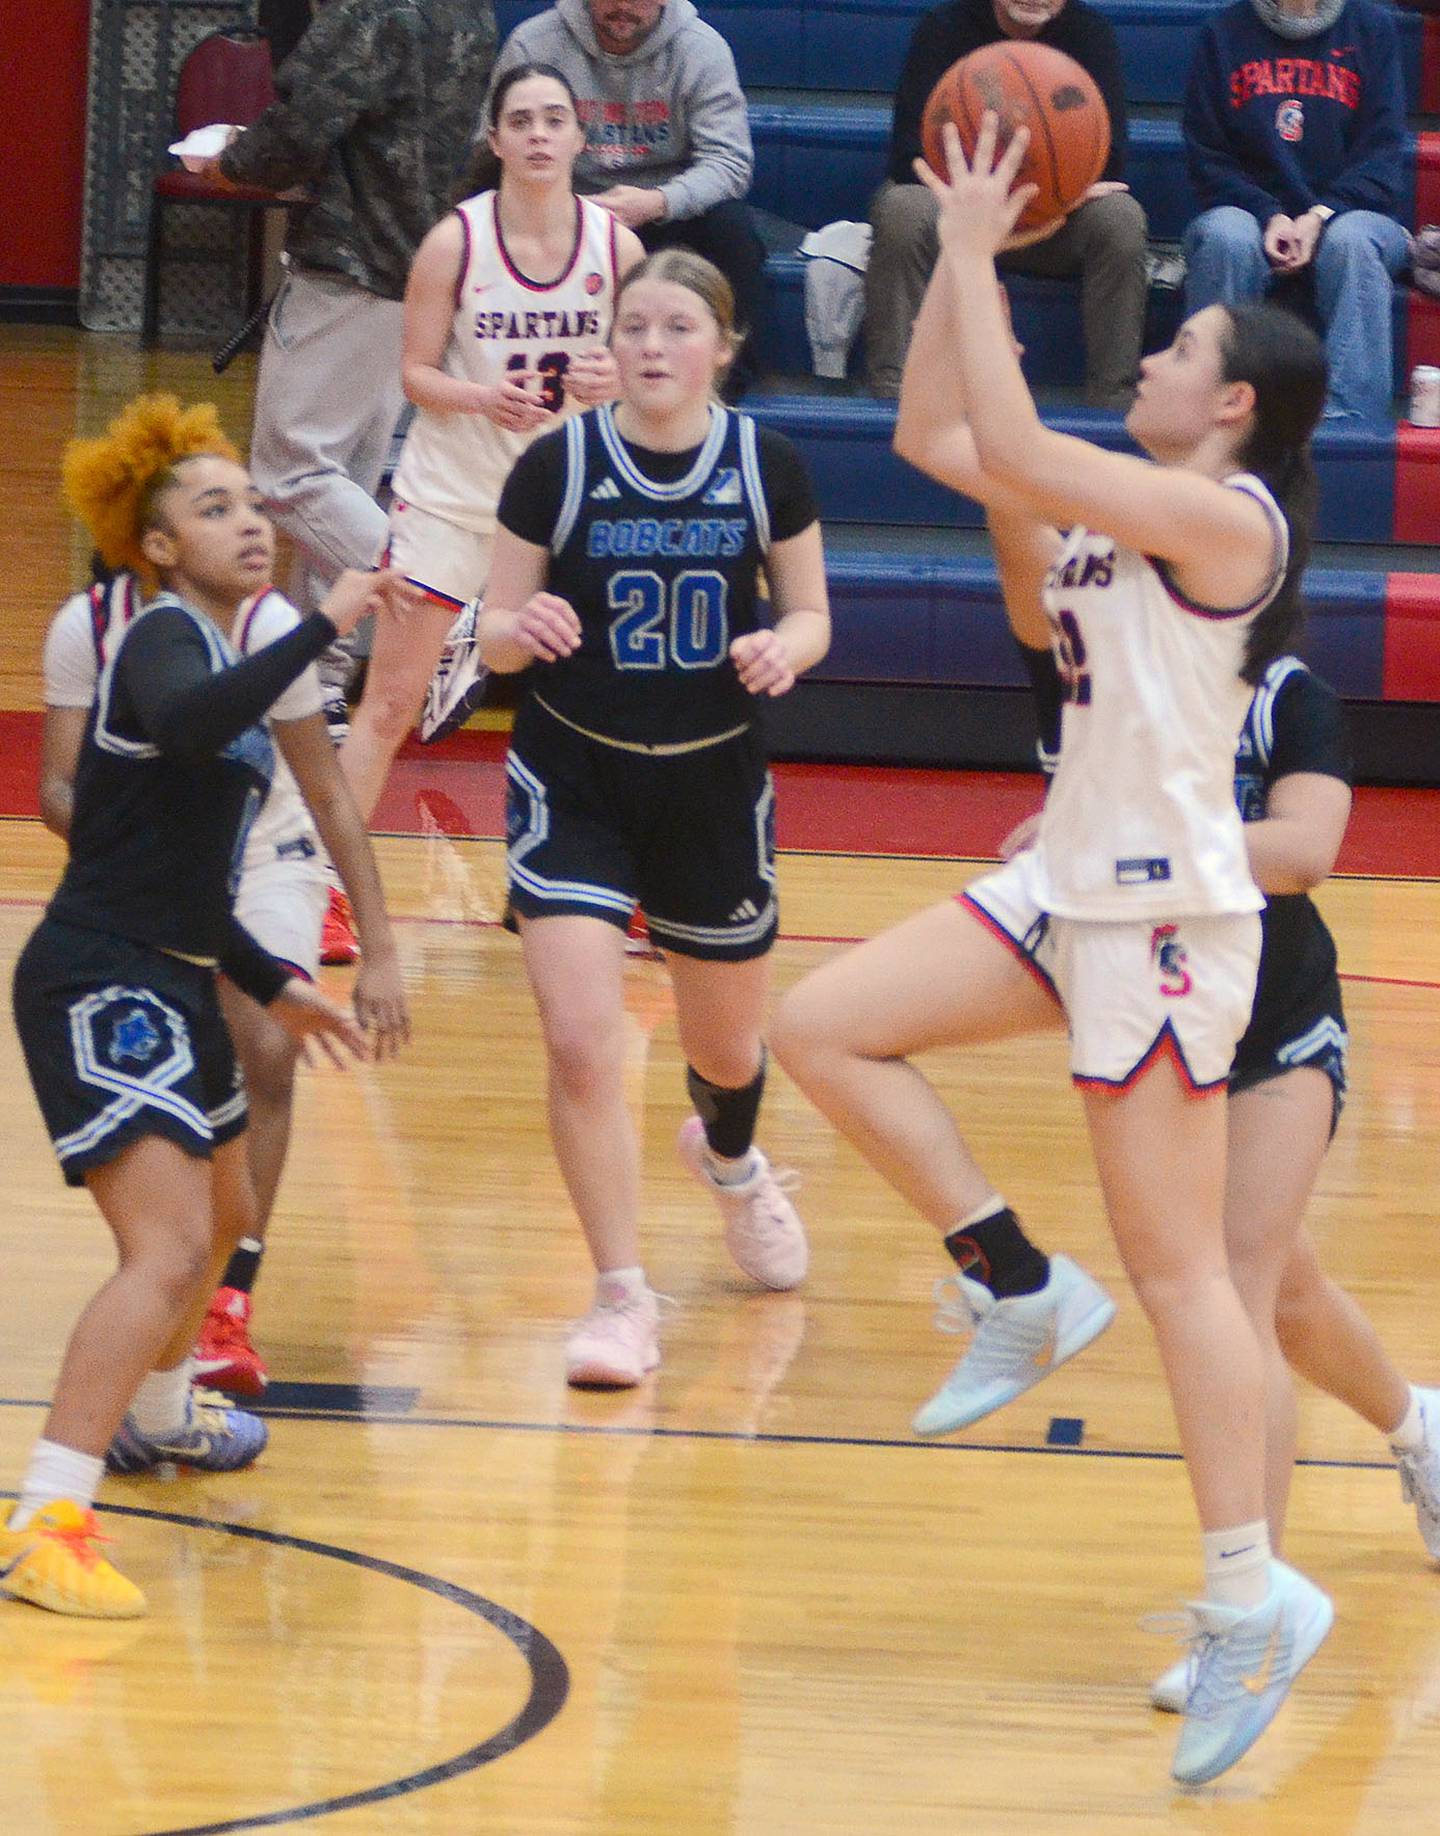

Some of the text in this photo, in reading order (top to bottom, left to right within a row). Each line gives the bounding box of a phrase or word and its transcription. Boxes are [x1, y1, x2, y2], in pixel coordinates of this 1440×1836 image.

[1230, 57, 1361, 109] SPARTANS
[474, 310, 598, 339] SPARTANS
[587, 518, 748, 558] BOBCATS
[608, 570, 728, 670] 20
